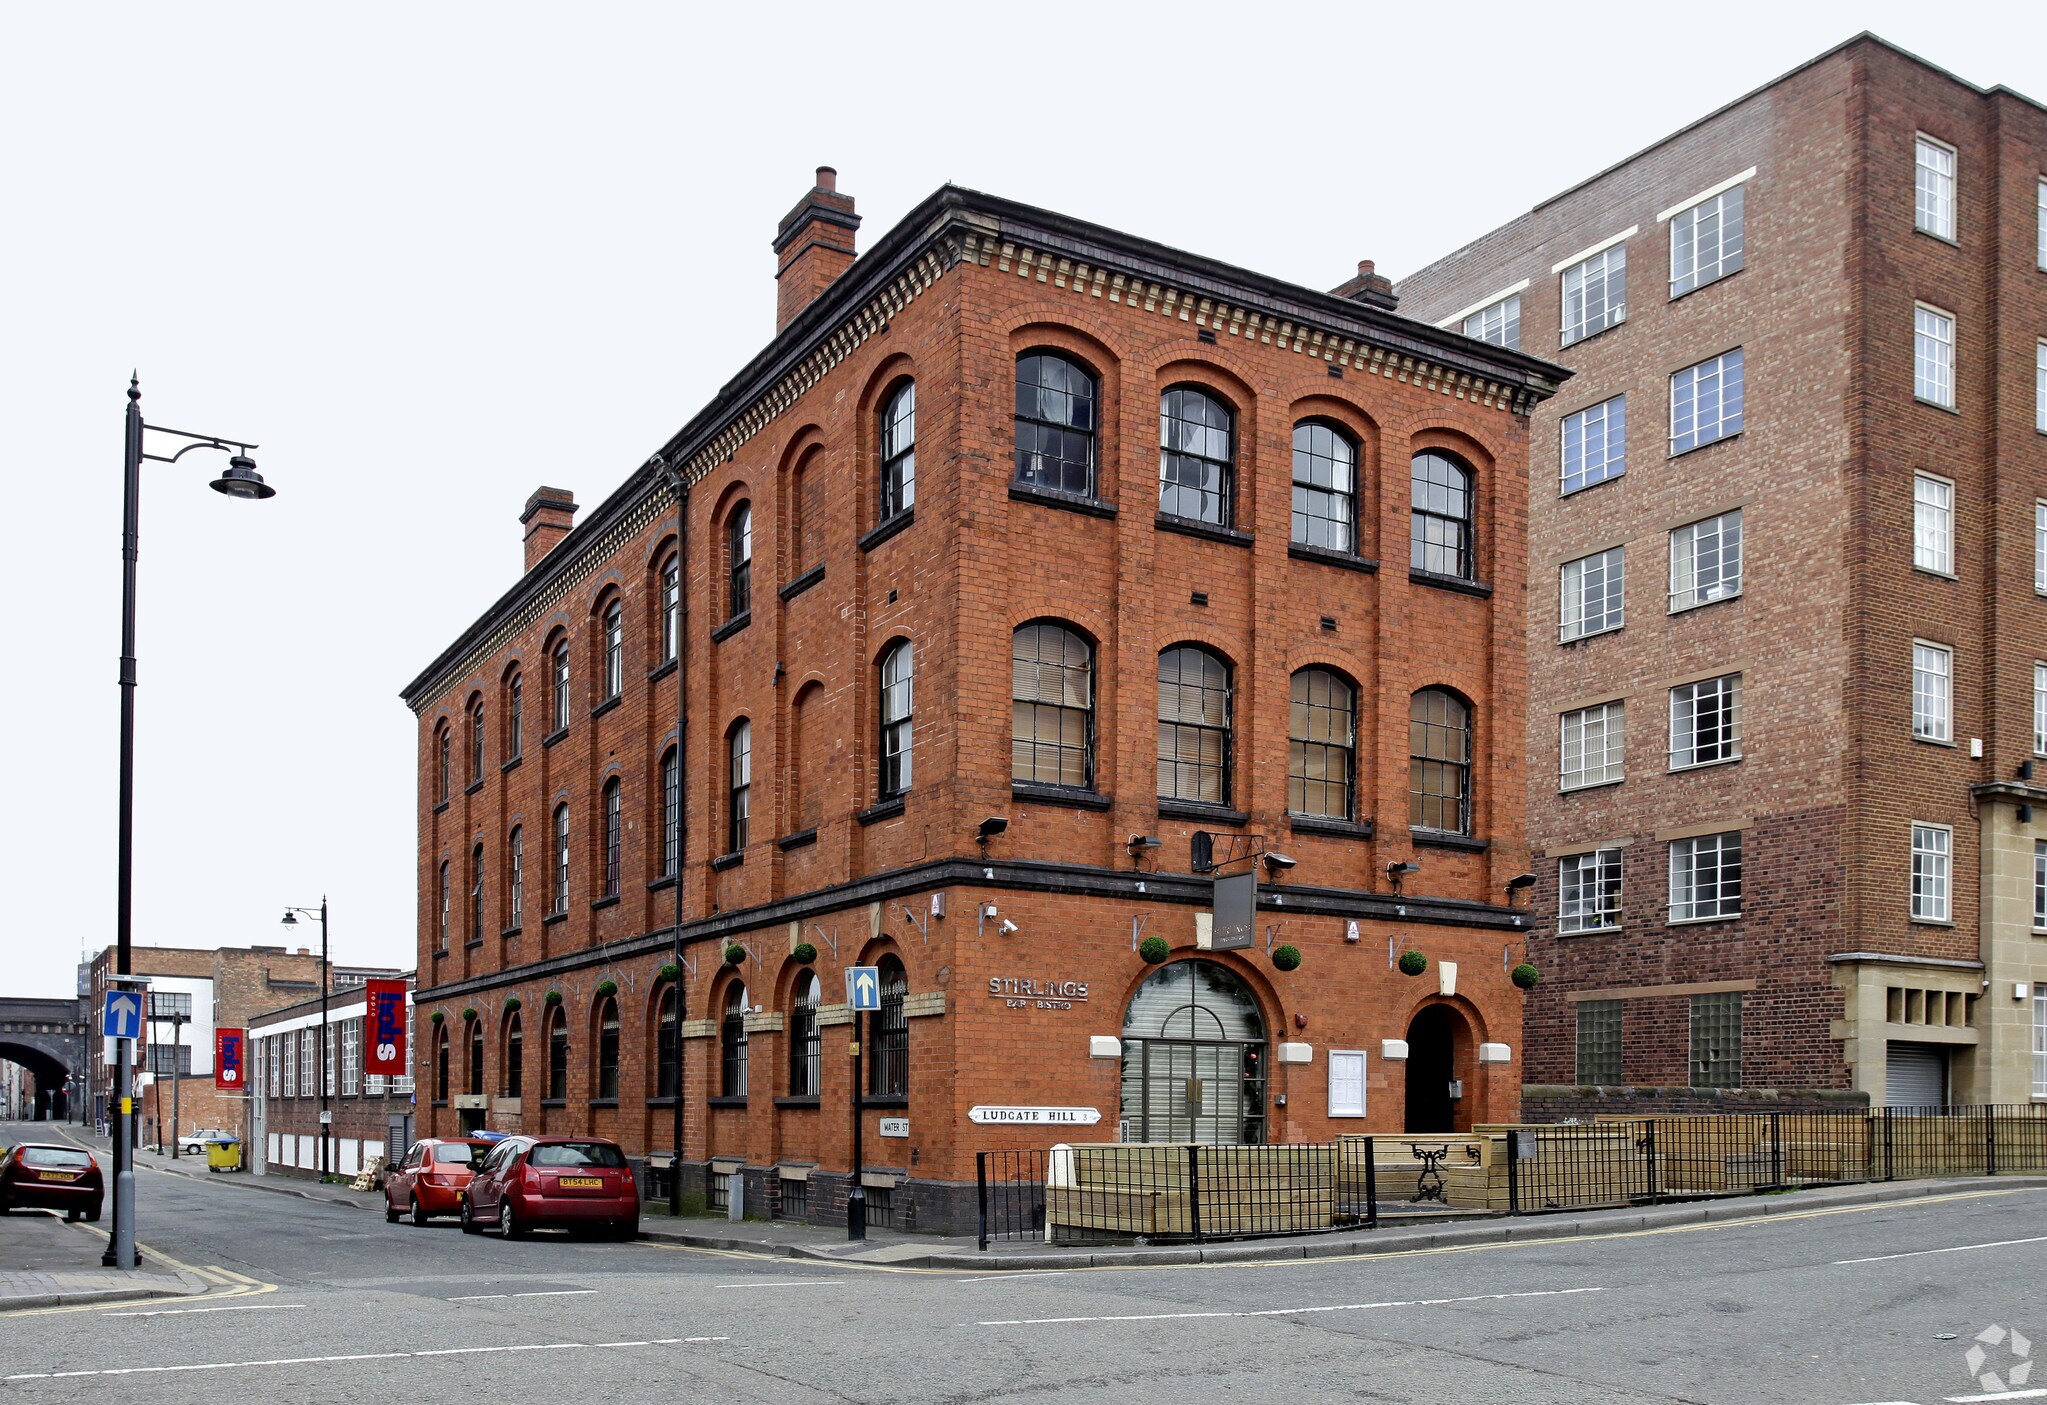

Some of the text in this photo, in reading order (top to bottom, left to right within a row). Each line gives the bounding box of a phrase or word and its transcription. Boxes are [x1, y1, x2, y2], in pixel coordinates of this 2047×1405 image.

[989, 977, 1089, 997] STIRLINGS
[1006, 999, 1072, 1010] BAR BISTRO
[983, 1111, 1039, 1121] LUDGATE
[1048, 1112, 1077, 1121] HILL
[883, 1122, 900, 1132] WATER
[563, 1178, 582, 1186] BT54
